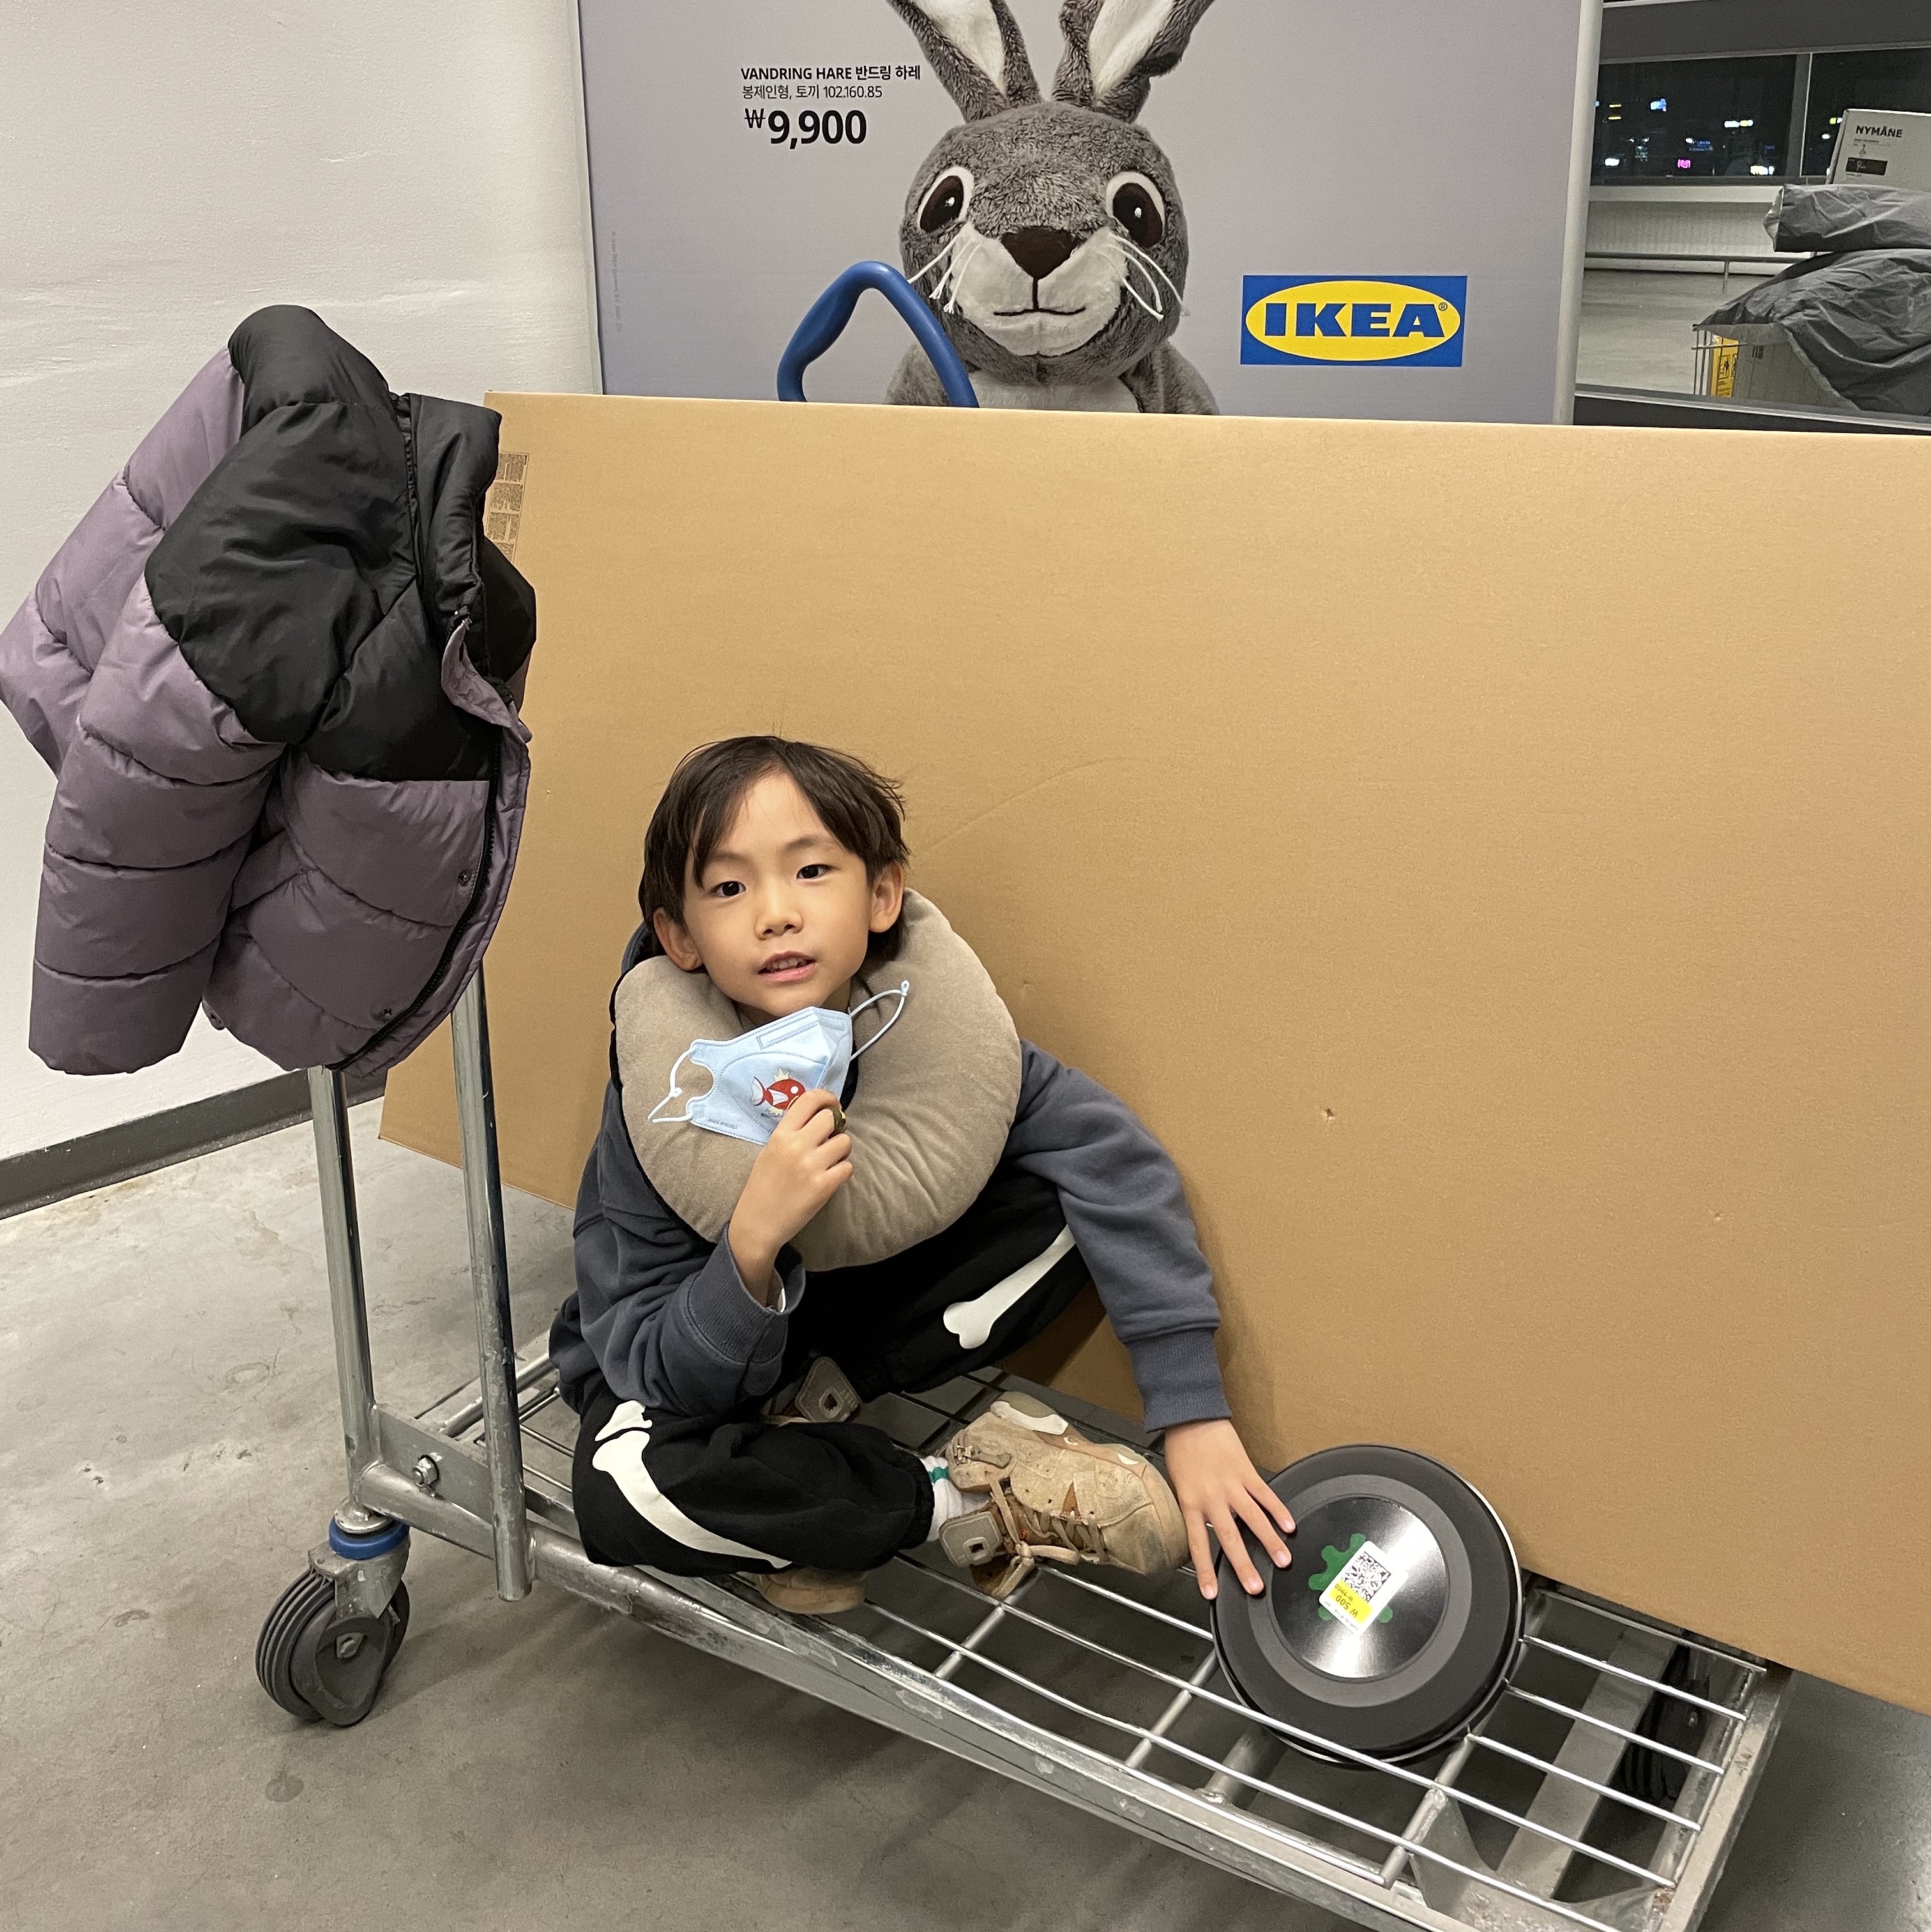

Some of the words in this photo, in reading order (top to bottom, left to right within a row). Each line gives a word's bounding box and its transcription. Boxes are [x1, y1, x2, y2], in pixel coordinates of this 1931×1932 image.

[741, 68, 812, 80] VANDRING
[816, 68, 852, 80] HARE
[856, 65, 891, 80] 반드링
[895, 65, 921, 80] 하레
[742, 85, 792, 100] 봉제인형,
[796, 84, 820, 99] 토끼
[823, 86, 882, 98] 102.160.85
[1264, 303, 1445, 338] IKEA
[1335, 1595, 1351, 1610] 500
